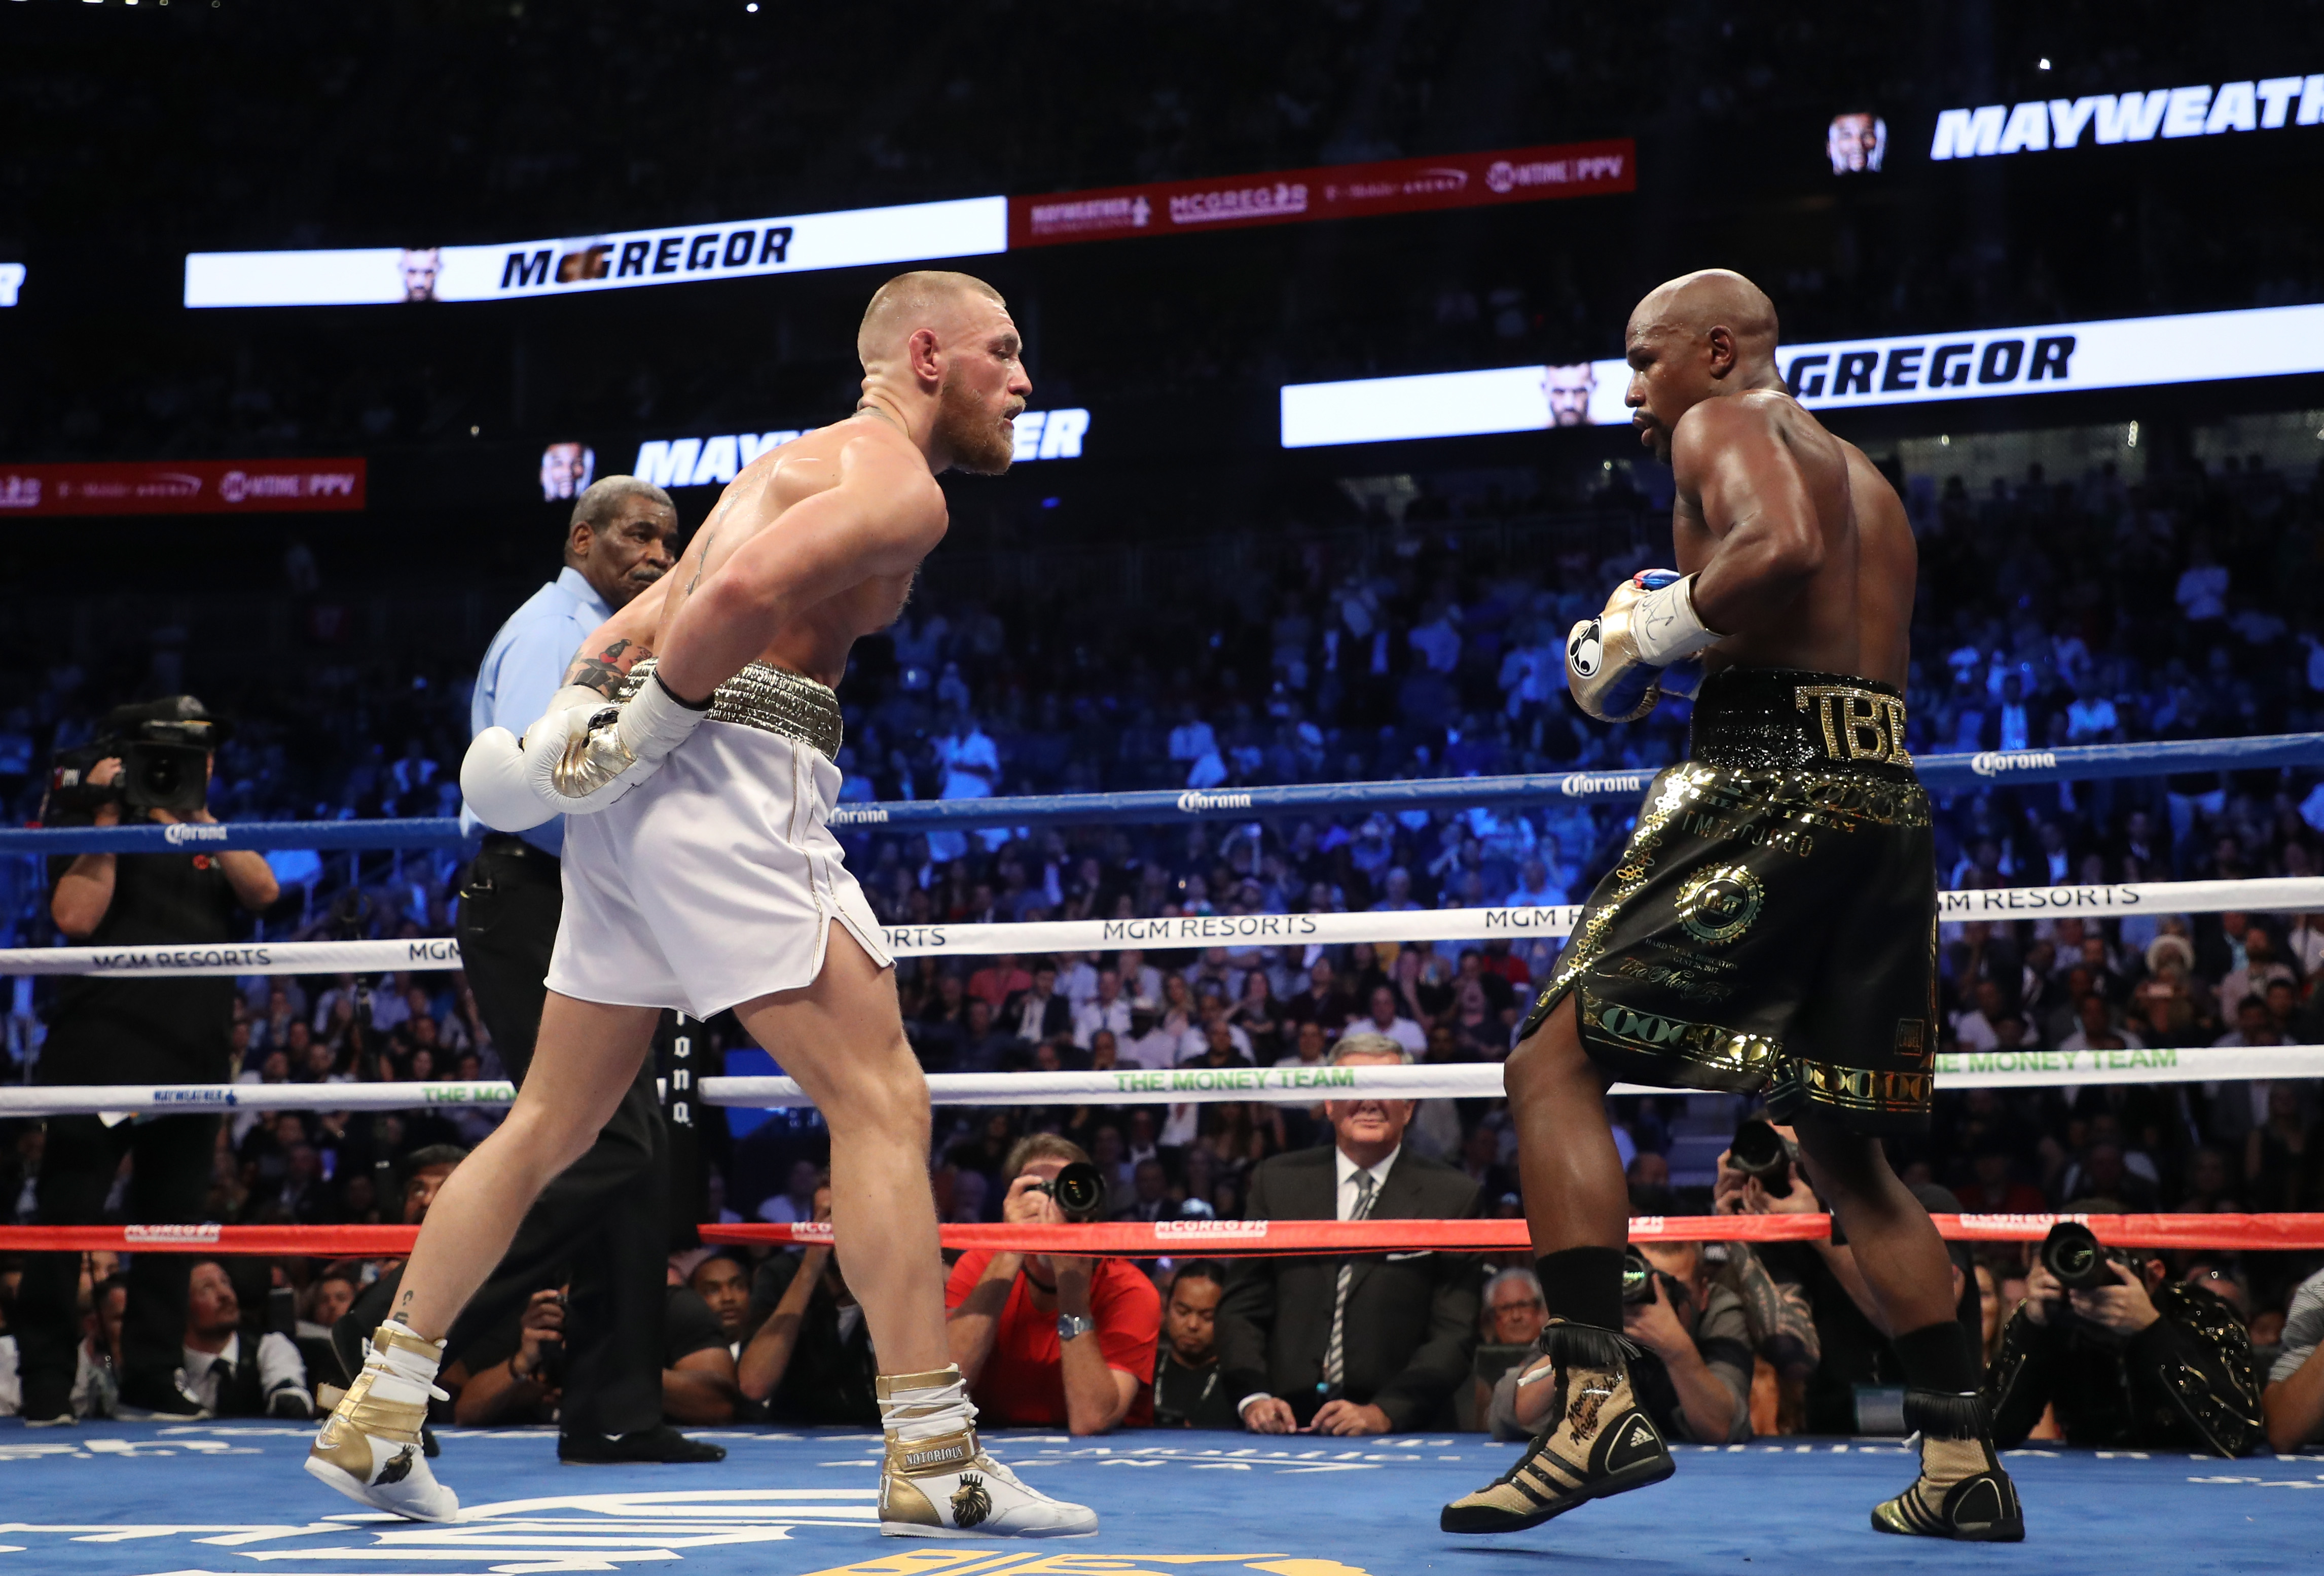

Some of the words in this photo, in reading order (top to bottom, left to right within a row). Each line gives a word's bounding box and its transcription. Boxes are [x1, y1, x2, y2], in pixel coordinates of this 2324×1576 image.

[1774, 336, 2077, 399] GREGOR
[1972, 751, 2056, 776] Corona
[1562, 773, 1640, 798] Corona
[1178, 791, 1251, 814] Corona
[164, 823, 228, 846] Corona
[1983, 885, 2141, 911] RESORTS
[1103, 919, 1169, 941] MGM
[1181, 915, 1317, 938] RESORTS
[1486, 909, 1555, 928] MGM
[155, 948, 271, 967] RESORTS
[1968, 1049, 2078, 1074] MONEY
[2084, 1048, 2177, 1069] TEAM
[1114, 1071, 1165, 1093] THE
[1172, 1069, 1269, 1091] MONEY
[1277, 1068, 1355, 1088] TEAM
[422, 1087, 467, 1101] THE
[906, 1445, 963, 1467] NOTORIOUS
